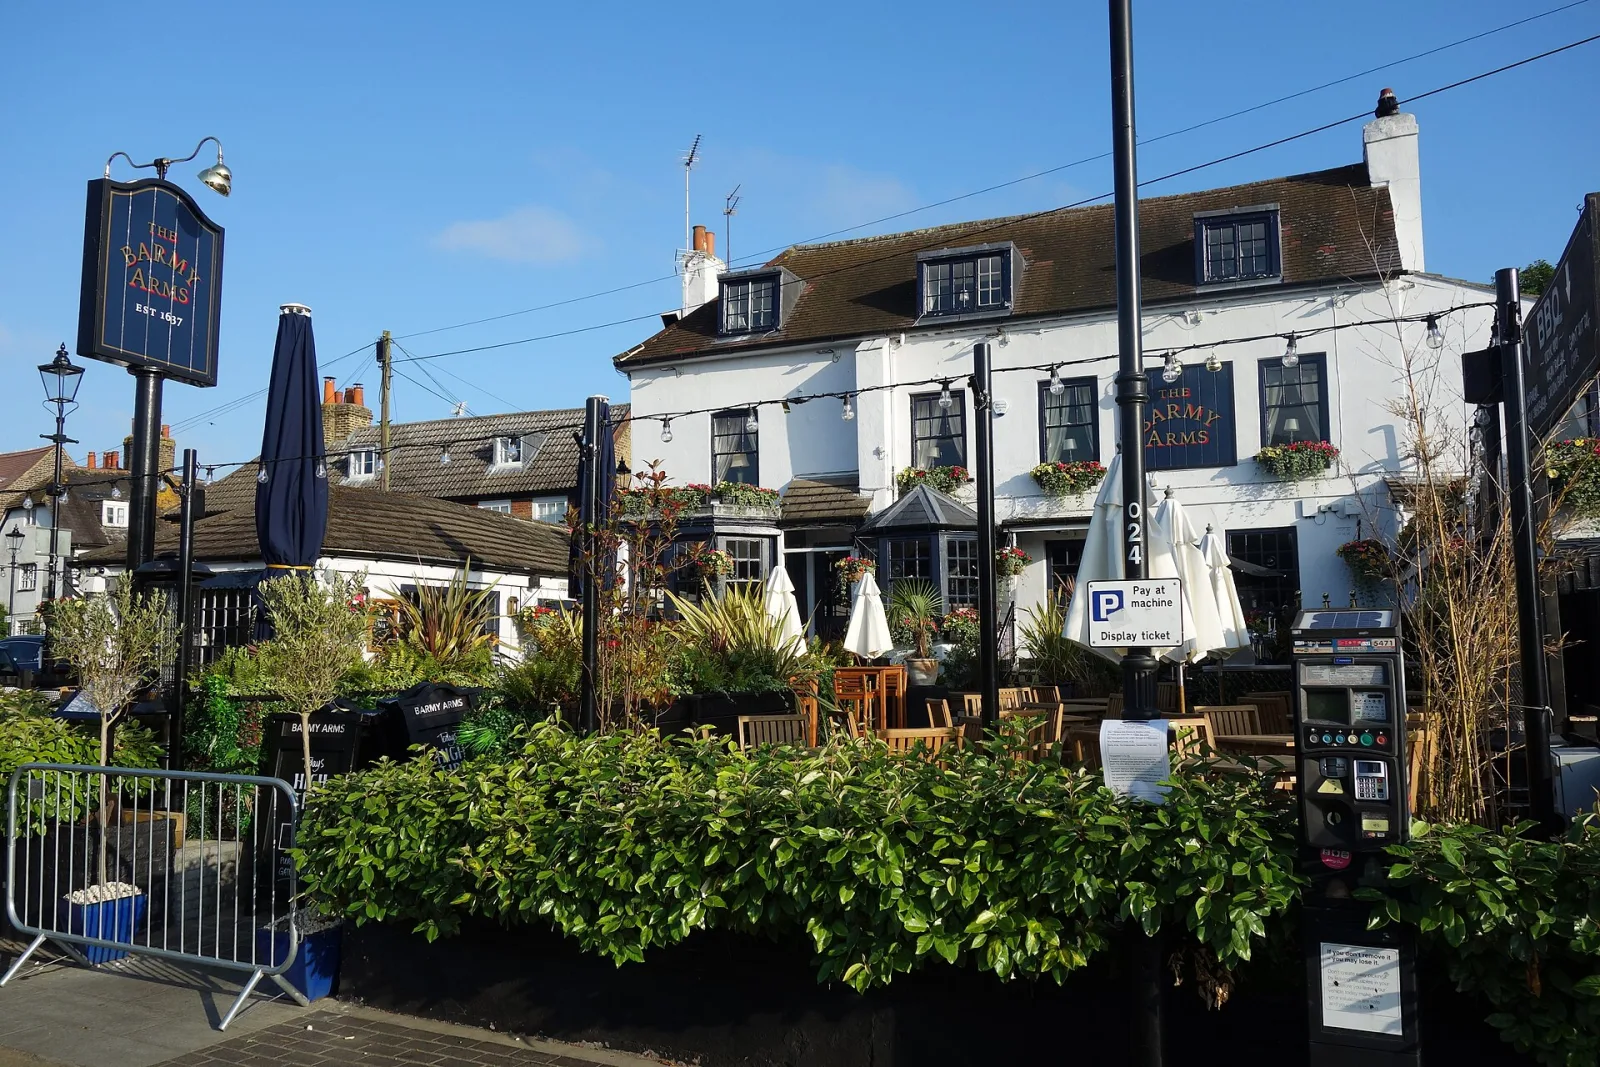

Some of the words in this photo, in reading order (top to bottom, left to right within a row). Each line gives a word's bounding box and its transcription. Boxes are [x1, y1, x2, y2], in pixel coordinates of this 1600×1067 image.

[147, 222, 178, 243] THE
[120, 242, 201, 288] BARMY
[129, 268, 190, 304] ARMS
[136, 303, 156, 317] EST
[160, 312, 183, 327] 1637
[1536, 286, 1564, 349] BBQ
[1158, 388, 1192, 400] THE
[1146, 430, 1210, 448] ARMS
[1128, 502, 1142, 564] 024
[1133, 586, 1151, 597] Pay
[1156, 586, 1166, 594] at
[1100, 594, 1120, 619] P
[1131, 598, 1173, 608] machine
[1100, 631, 1138, 642] Display
[1142, 630, 1170, 640] ticket
[414, 702, 441, 715] BARMY
[442, 698, 464, 710] ARMS
[292, 723, 321, 733] BAMY
[322, 723, 346, 733] ARMS
